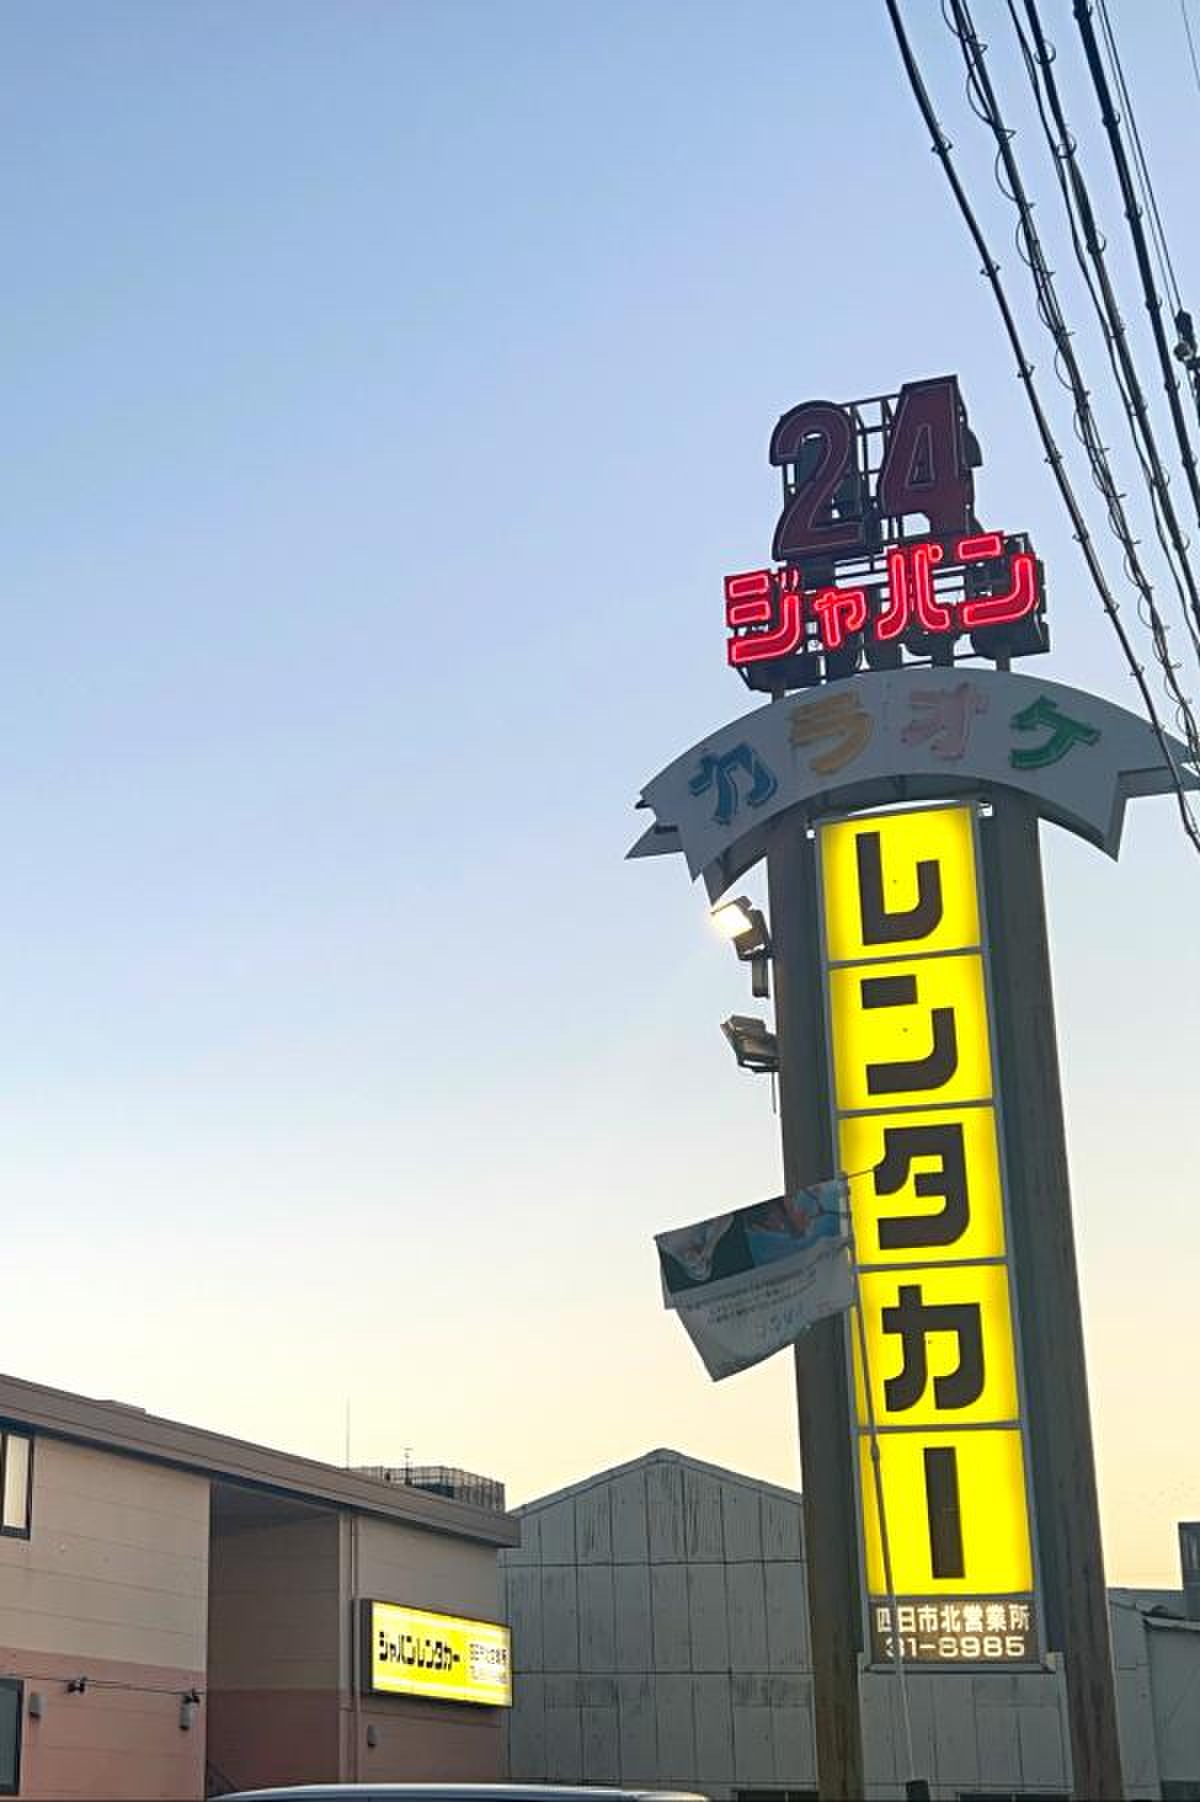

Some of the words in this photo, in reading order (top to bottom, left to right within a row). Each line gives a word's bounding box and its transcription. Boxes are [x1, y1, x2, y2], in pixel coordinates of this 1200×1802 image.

[769, 375, 972, 560] 24
[724, 531, 1038, 667] ジャパン
[688, 682, 1101, 824] カラオケ
[855, 831, 986, 1580] レンタカー
[876, 1604, 1030, 1633] 四日市北営業所
